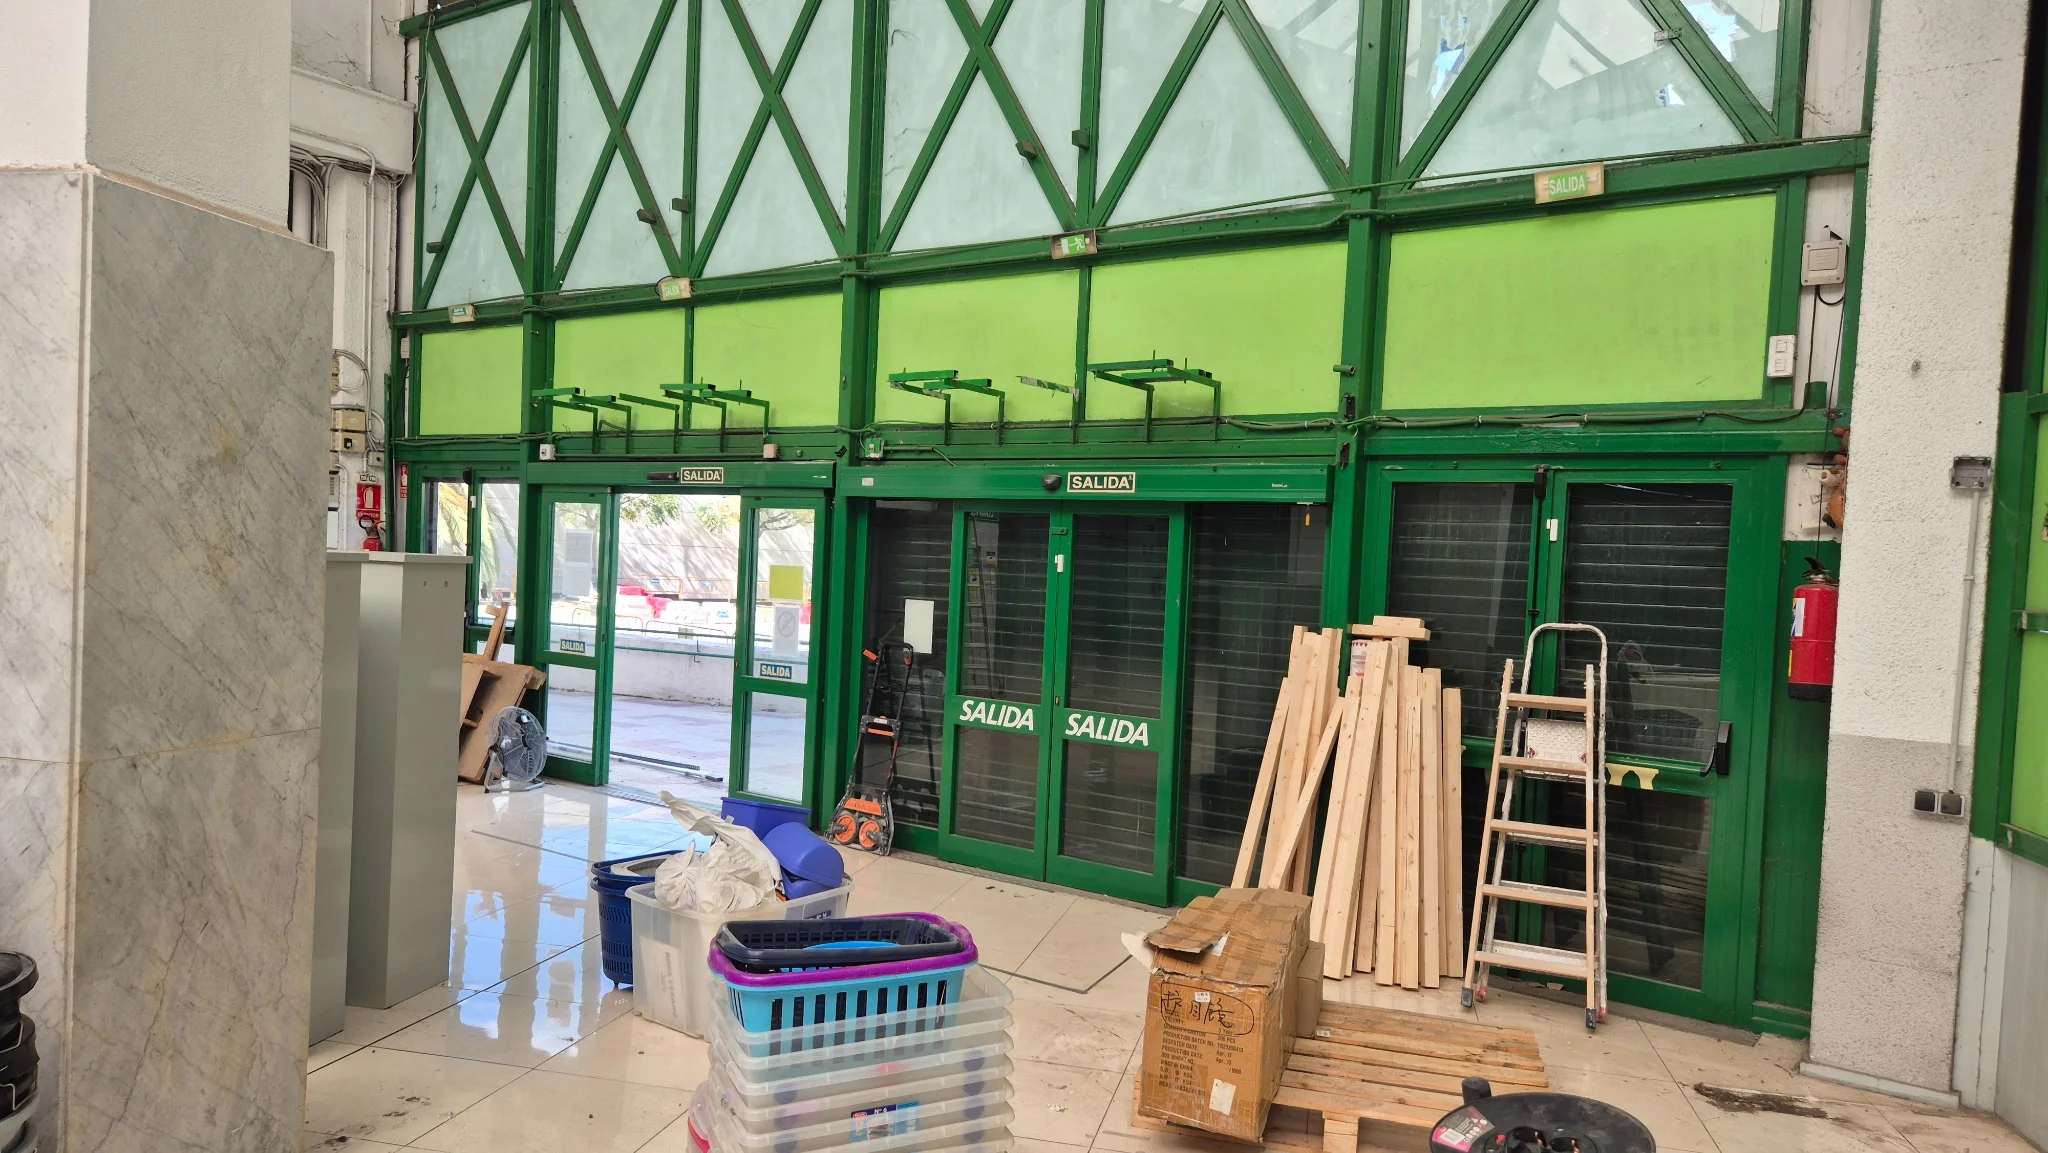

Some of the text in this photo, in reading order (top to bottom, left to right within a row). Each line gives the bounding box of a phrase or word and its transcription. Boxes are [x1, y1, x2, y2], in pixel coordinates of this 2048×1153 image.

[1550, 175, 1586, 196] SALIDA
[683, 470, 721, 481] SALIDA
[1072, 475, 1130, 489] SALIDA
[561, 640, 585, 652] SALIDA
[761, 664, 791, 677] SALIDA
[959, 699, 1034, 731] SALIDA
[1065, 713, 1149, 747] SALIDA
